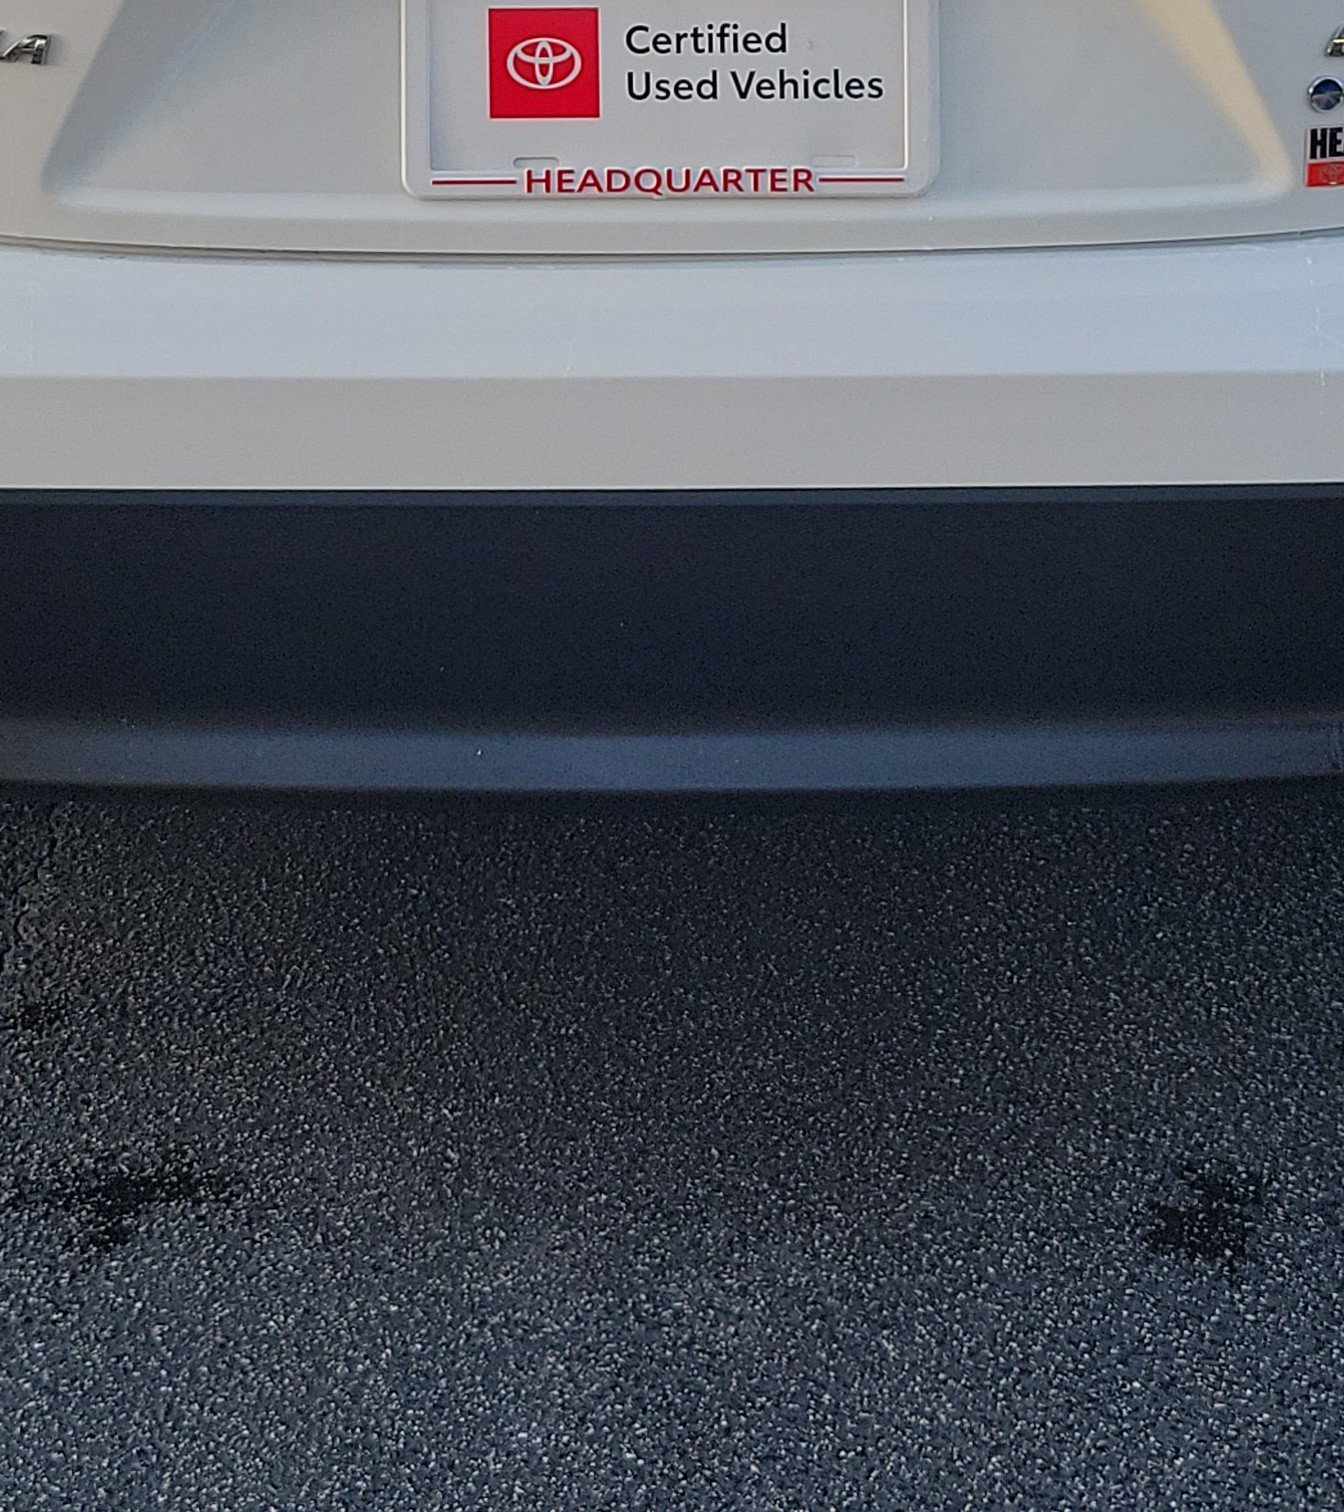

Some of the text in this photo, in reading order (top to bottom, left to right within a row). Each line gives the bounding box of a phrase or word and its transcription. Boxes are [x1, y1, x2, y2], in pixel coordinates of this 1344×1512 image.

[624, 22, 788, 55] Certified
[626, 67, 884, 101] Used Vehicles
[523, 167, 816, 197] HEADQUARTER
